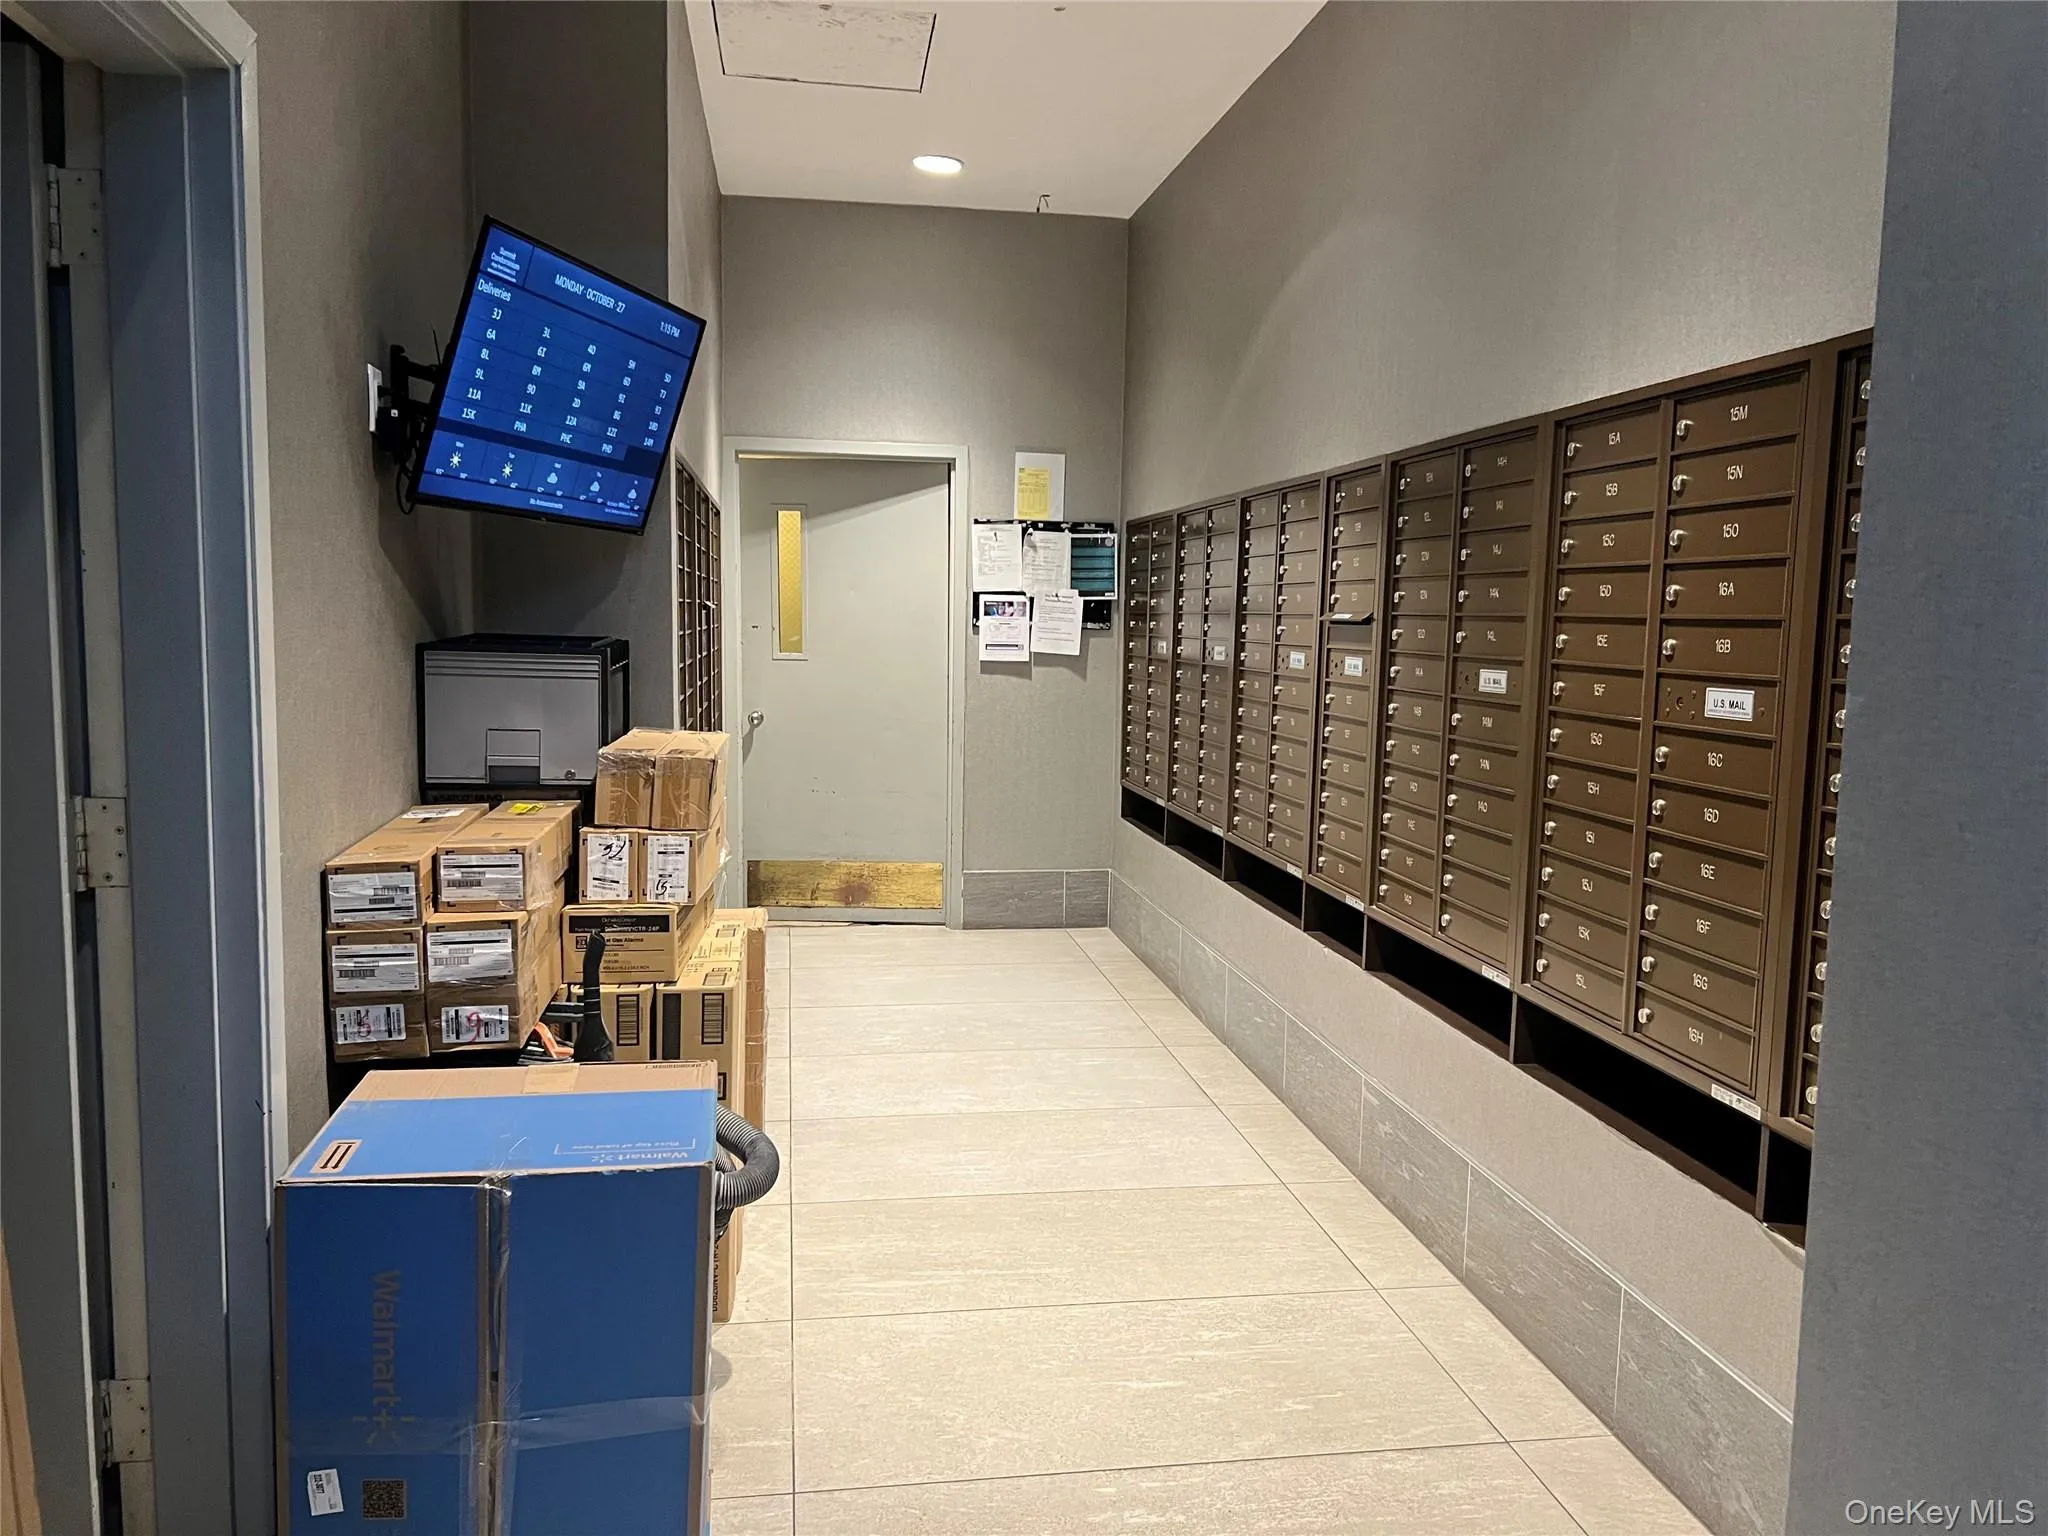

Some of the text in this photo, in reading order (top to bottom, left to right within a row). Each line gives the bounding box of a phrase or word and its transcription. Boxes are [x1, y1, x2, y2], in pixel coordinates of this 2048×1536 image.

[478, 278, 512, 302] Deliveries
[555, 274, 626, 313] MONDAY OCTOBER 27
[492, 308, 501, 320] 3J
[487, 329, 495, 340] 6A
[481, 349, 489, 360] 8L
[476, 368, 483, 379] 9L
[468, 388, 481, 400] 11A
[1731, 405, 1748, 420] 15M
[1609, 432, 1620, 444] 15A
[1727, 466, 1743, 480] 15N
[1606, 483, 1617, 496] 15B
[1603, 534, 1614, 546] 15C
[1600, 585, 1611, 596] 15D
[1719, 583, 1734, 595] 16A
[1597, 635, 1607, 646] 15E
[1716, 640, 1730, 652] 16B
[1594, 684, 1605, 695] 15F
[1713, 698, 1746, 711] U.S. MAIL
[1591, 733, 1602, 745] 15G
[1708, 753, 1722, 767] 16C
[1588, 782, 1599, 794] 15H
[1704, 808, 1718, 822] 16D
[1586, 831, 1594, 843] 15I
[1701, 864, 1715, 879] 16E
[1582, 879, 1592, 891] 15J
[1697, 919, 1711, 934] 16F
[1579, 926, 1589, 940] 15K
[1576, 974, 1586, 988] 15L
[1693, 974, 1707, 989] 16G
[1689, 1028, 1703, 1045] 16H
[618, 1152, 688, 1161] Walmart
[369, 1269, 401, 1405] Walmart
